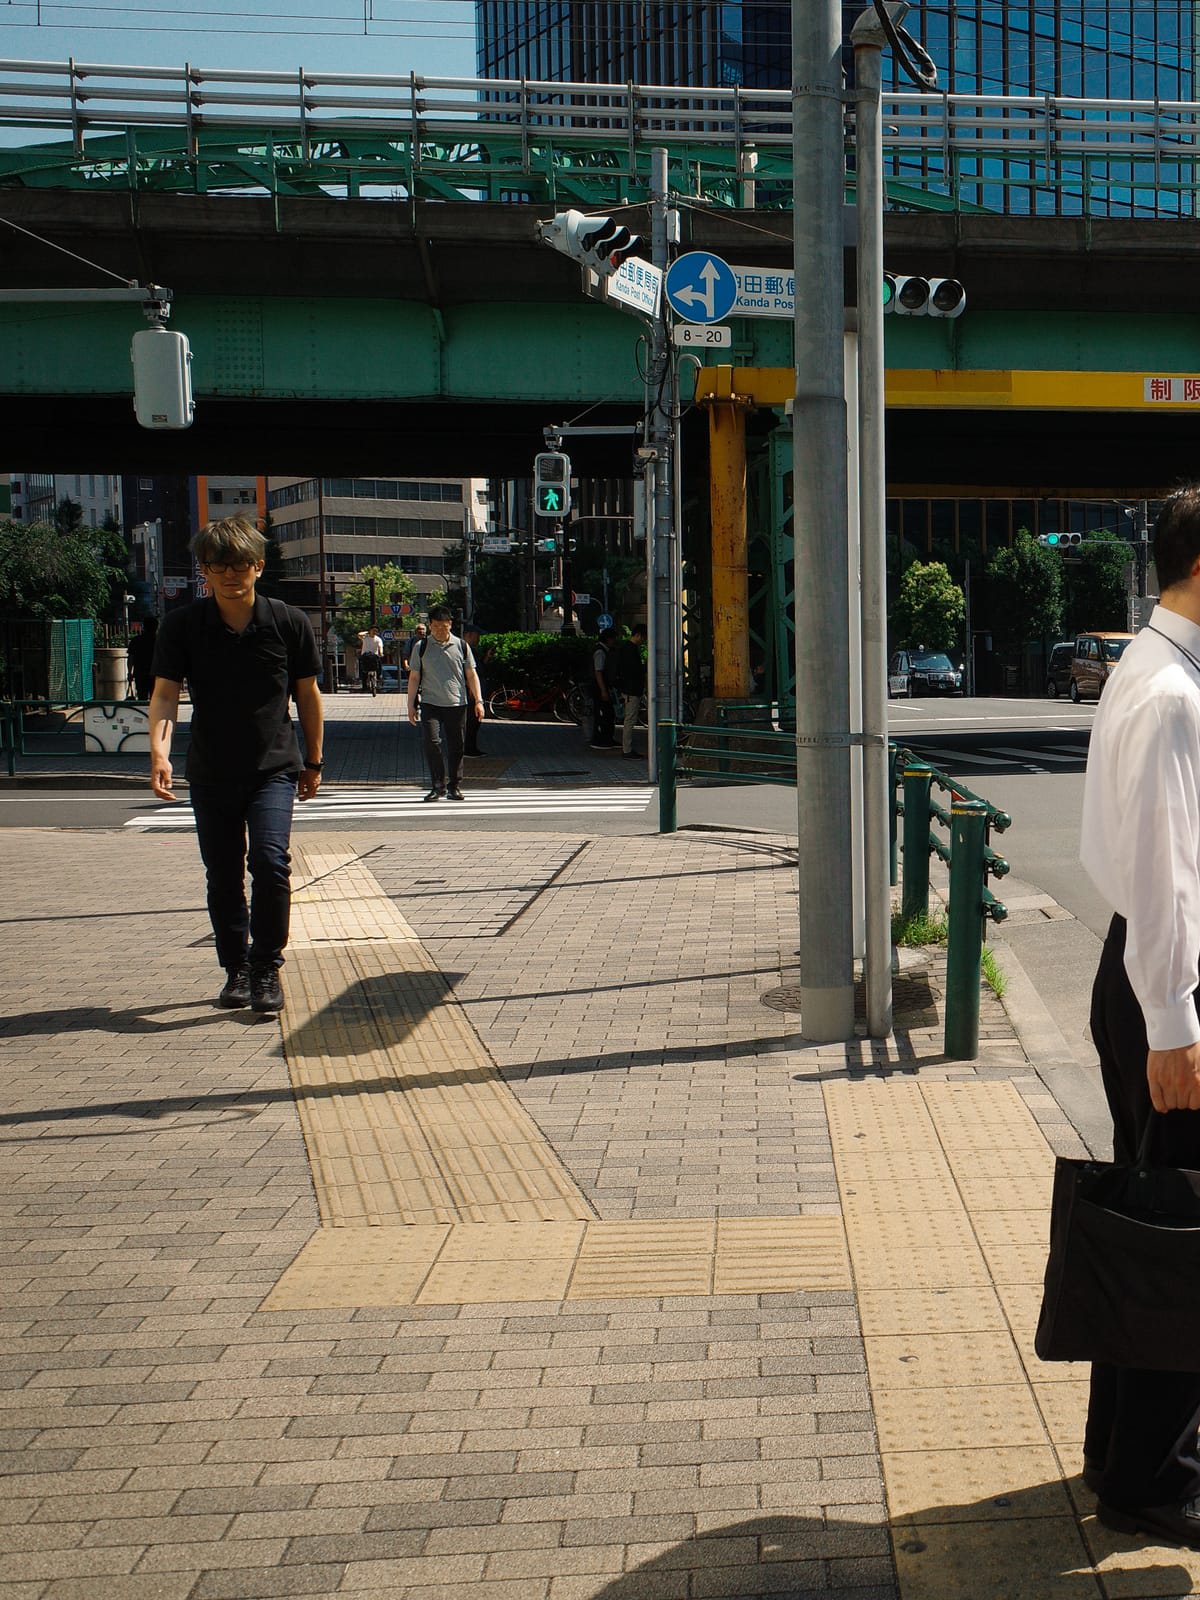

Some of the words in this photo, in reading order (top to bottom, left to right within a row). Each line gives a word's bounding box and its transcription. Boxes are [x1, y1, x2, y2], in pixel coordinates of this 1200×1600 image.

[620, 262, 659, 294] 田郵便局前
[736, 296, 769, 308] Kanda
[774, 298, 794, 310] Pos
